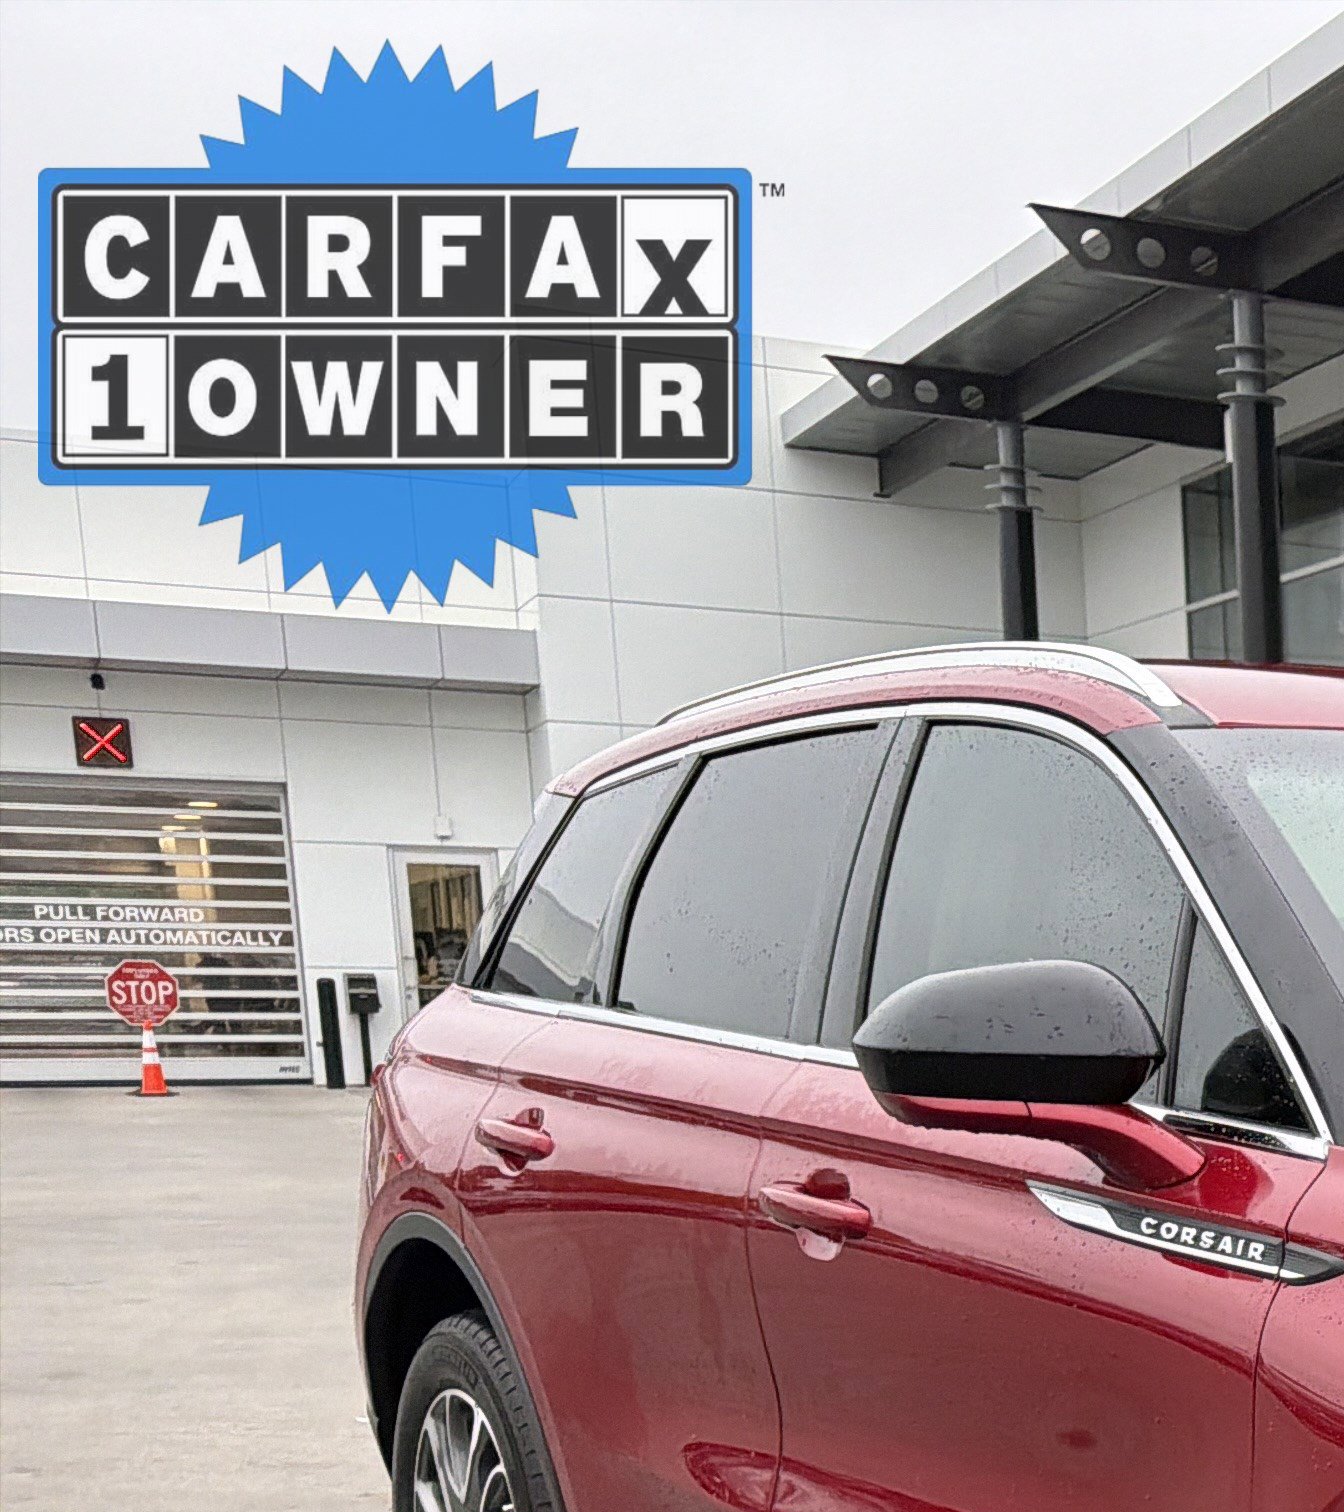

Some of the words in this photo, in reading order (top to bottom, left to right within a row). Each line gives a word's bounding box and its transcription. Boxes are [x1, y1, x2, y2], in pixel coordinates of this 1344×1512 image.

[33, 904, 91, 920] PULL
[95, 906, 205, 923] FORWARD
[0, 926, 35, 943] RS
[39, 927, 101, 944] OPEN
[106, 929, 283, 946] AUTOMATICALLY
[111, 980, 174, 1005] STOP
[1140, 1216, 1266, 1262] CORSAIR
